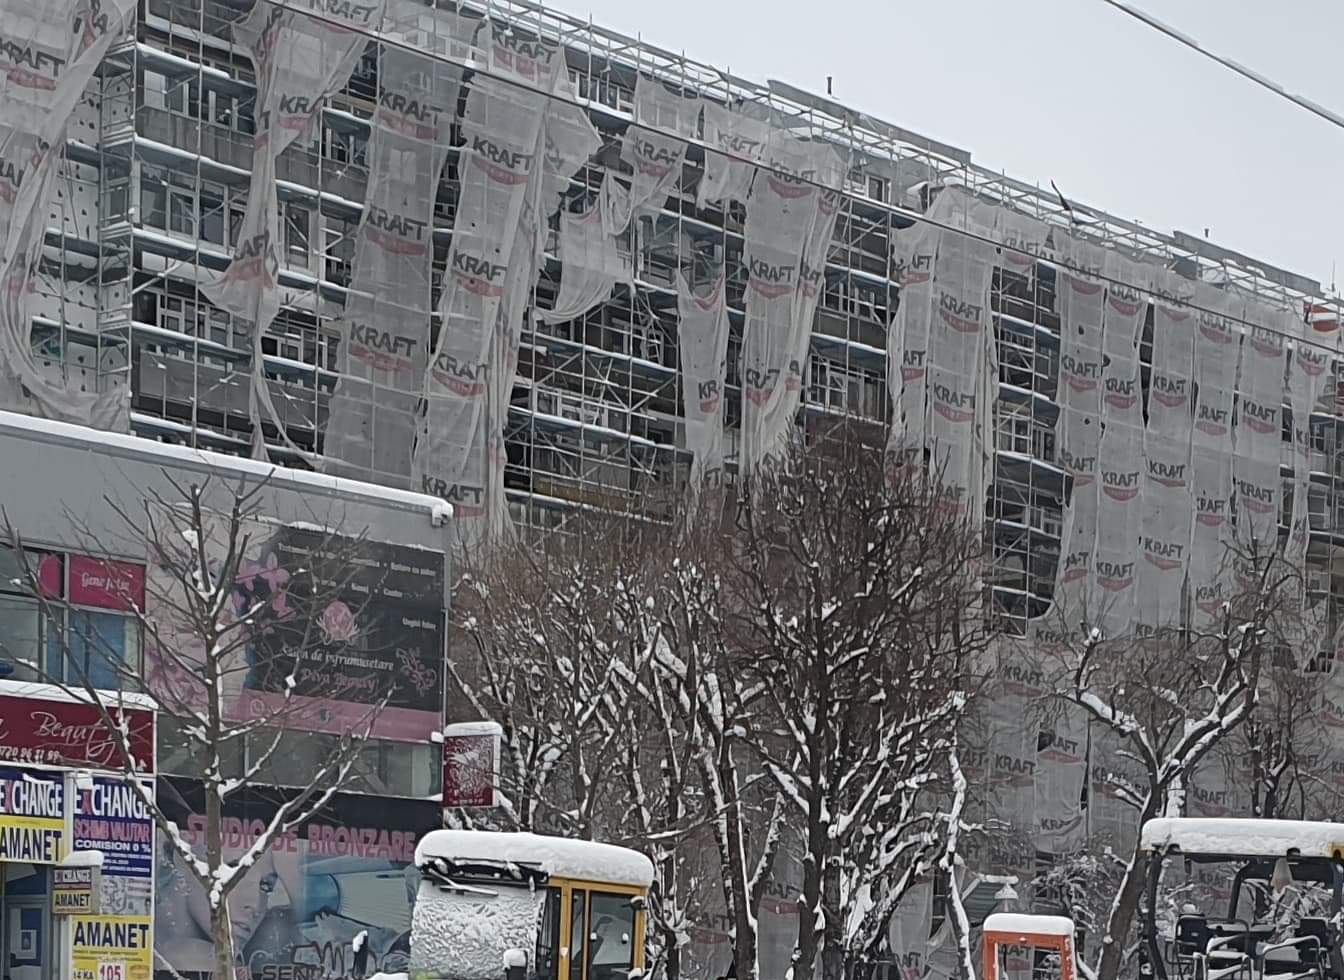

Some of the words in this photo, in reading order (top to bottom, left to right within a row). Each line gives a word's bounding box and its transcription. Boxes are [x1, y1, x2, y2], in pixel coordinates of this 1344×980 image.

[380, 91, 442, 125] KRAFT
[472, 136, 534, 171] KRAFT
[635, 136, 682, 164] KRAF
[455, 253, 507, 281] KRAF
[749, 254, 795, 282] KRAFT
[940, 291, 983, 321] KRAFT
[351, 320, 417, 357] KRAFT
[904, 350, 927, 367] AFT
[1061, 354, 1097, 378] KRAFT
[934, 382, 976, 409] KRAFT
[1106, 378, 1136, 395] KRAF
[1153, 376, 1187, 394] KRAFT
[1199, 404, 1228, 424] RAFT
[1243, 400, 1277, 423] KRAFT
[422, 474, 484, 504] KRAFT
[1102, 472, 1140, 486] KRAFT
[1240, 479, 1275, 503] KRAFT
[1144, 537, 1184, 559] KRAFT
[1096, 562, 1135, 577] KRAFT
[31, 710, 118, 764] Beauty
[1049, 737, 1079, 754] RAFT
[995, 754, 1036, 776] KRAFT
[74, 783, 152, 820] EXCHANGE
[0, 825, 63, 862] AMANET
[74, 818, 110, 841] SCHIMB
[110, 820, 151, 843] VALUTAR
[307, 824, 417, 861] BRONZARE
[75, 839, 131, 851] COMISION
[73, 921, 150, 949] AMANET
